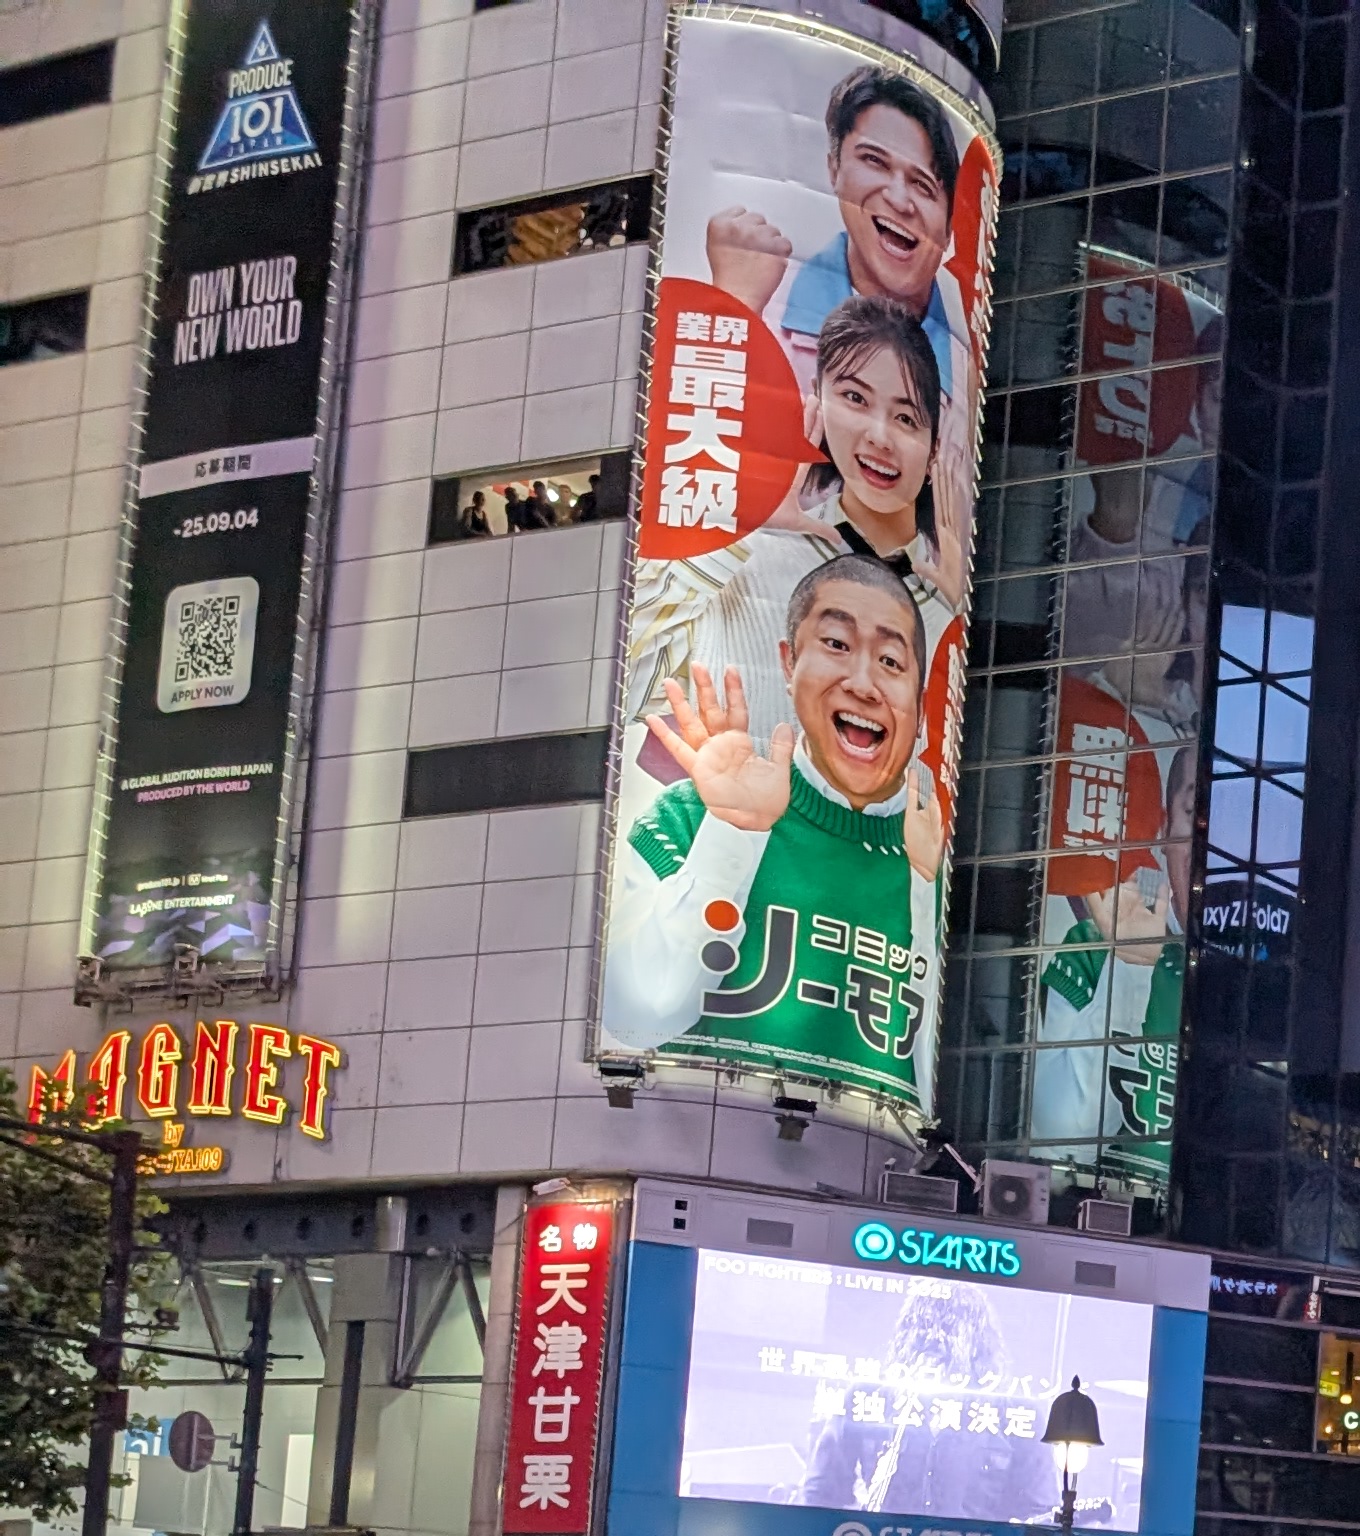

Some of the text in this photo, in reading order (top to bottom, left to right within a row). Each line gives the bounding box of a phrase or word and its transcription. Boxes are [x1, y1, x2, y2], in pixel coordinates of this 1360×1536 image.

[228, 59, 294, 98] PRODUCE
[230, 97, 284, 143] 101
[187, 255, 297, 318] OWN YOUR
[173, 300, 303, 366] NEW WORLD
[675, 311, 749, 346] 業界
[657, 344, 748, 534] 最大級
[171, 684, 234, 704] APPLY NOW
[129, 774, 161, 790] GLOBAL
[160, 769, 203, 786] AUDITION
[203, 766, 231, 780] BORN
[241, 762, 273, 776] JAPAN
[137, 785, 184, 803] PRODUCED
[215, 779, 251, 794] WORLD
[811, 913, 928, 982] コミック
[163, 1120, 185, 1148] by
[539, 1222, 599, 1252] 名物
[703, 1256, 746, 1276] FOO
[747, 1261, 832, 1286] FIGHTERS
[844, 1274, 884, 1292] LIVE
[885, 1280, 904, 1294] IN
[518, 1263, 592, 1511] 天津甘栗
